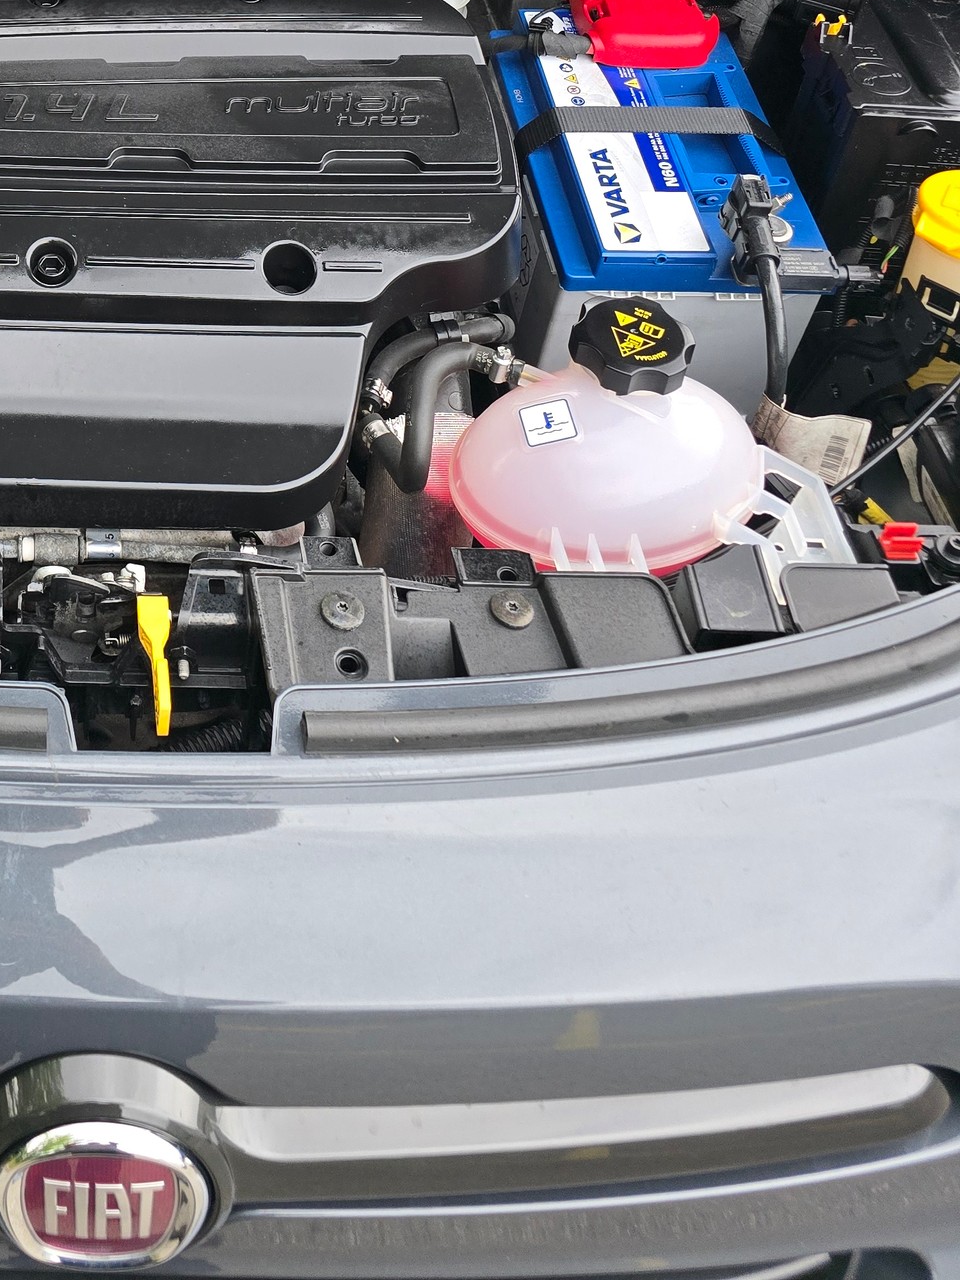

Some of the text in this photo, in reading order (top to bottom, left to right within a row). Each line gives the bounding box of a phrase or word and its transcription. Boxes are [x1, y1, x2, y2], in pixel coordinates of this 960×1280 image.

[224, 90, 421, 115] multiair
[336, 111, 420, 127] turbo
[589, 148, 630, 218] VARTA
[658, 161, 680, 187] N60
[43, 1177, 165, 1240] FIAT
